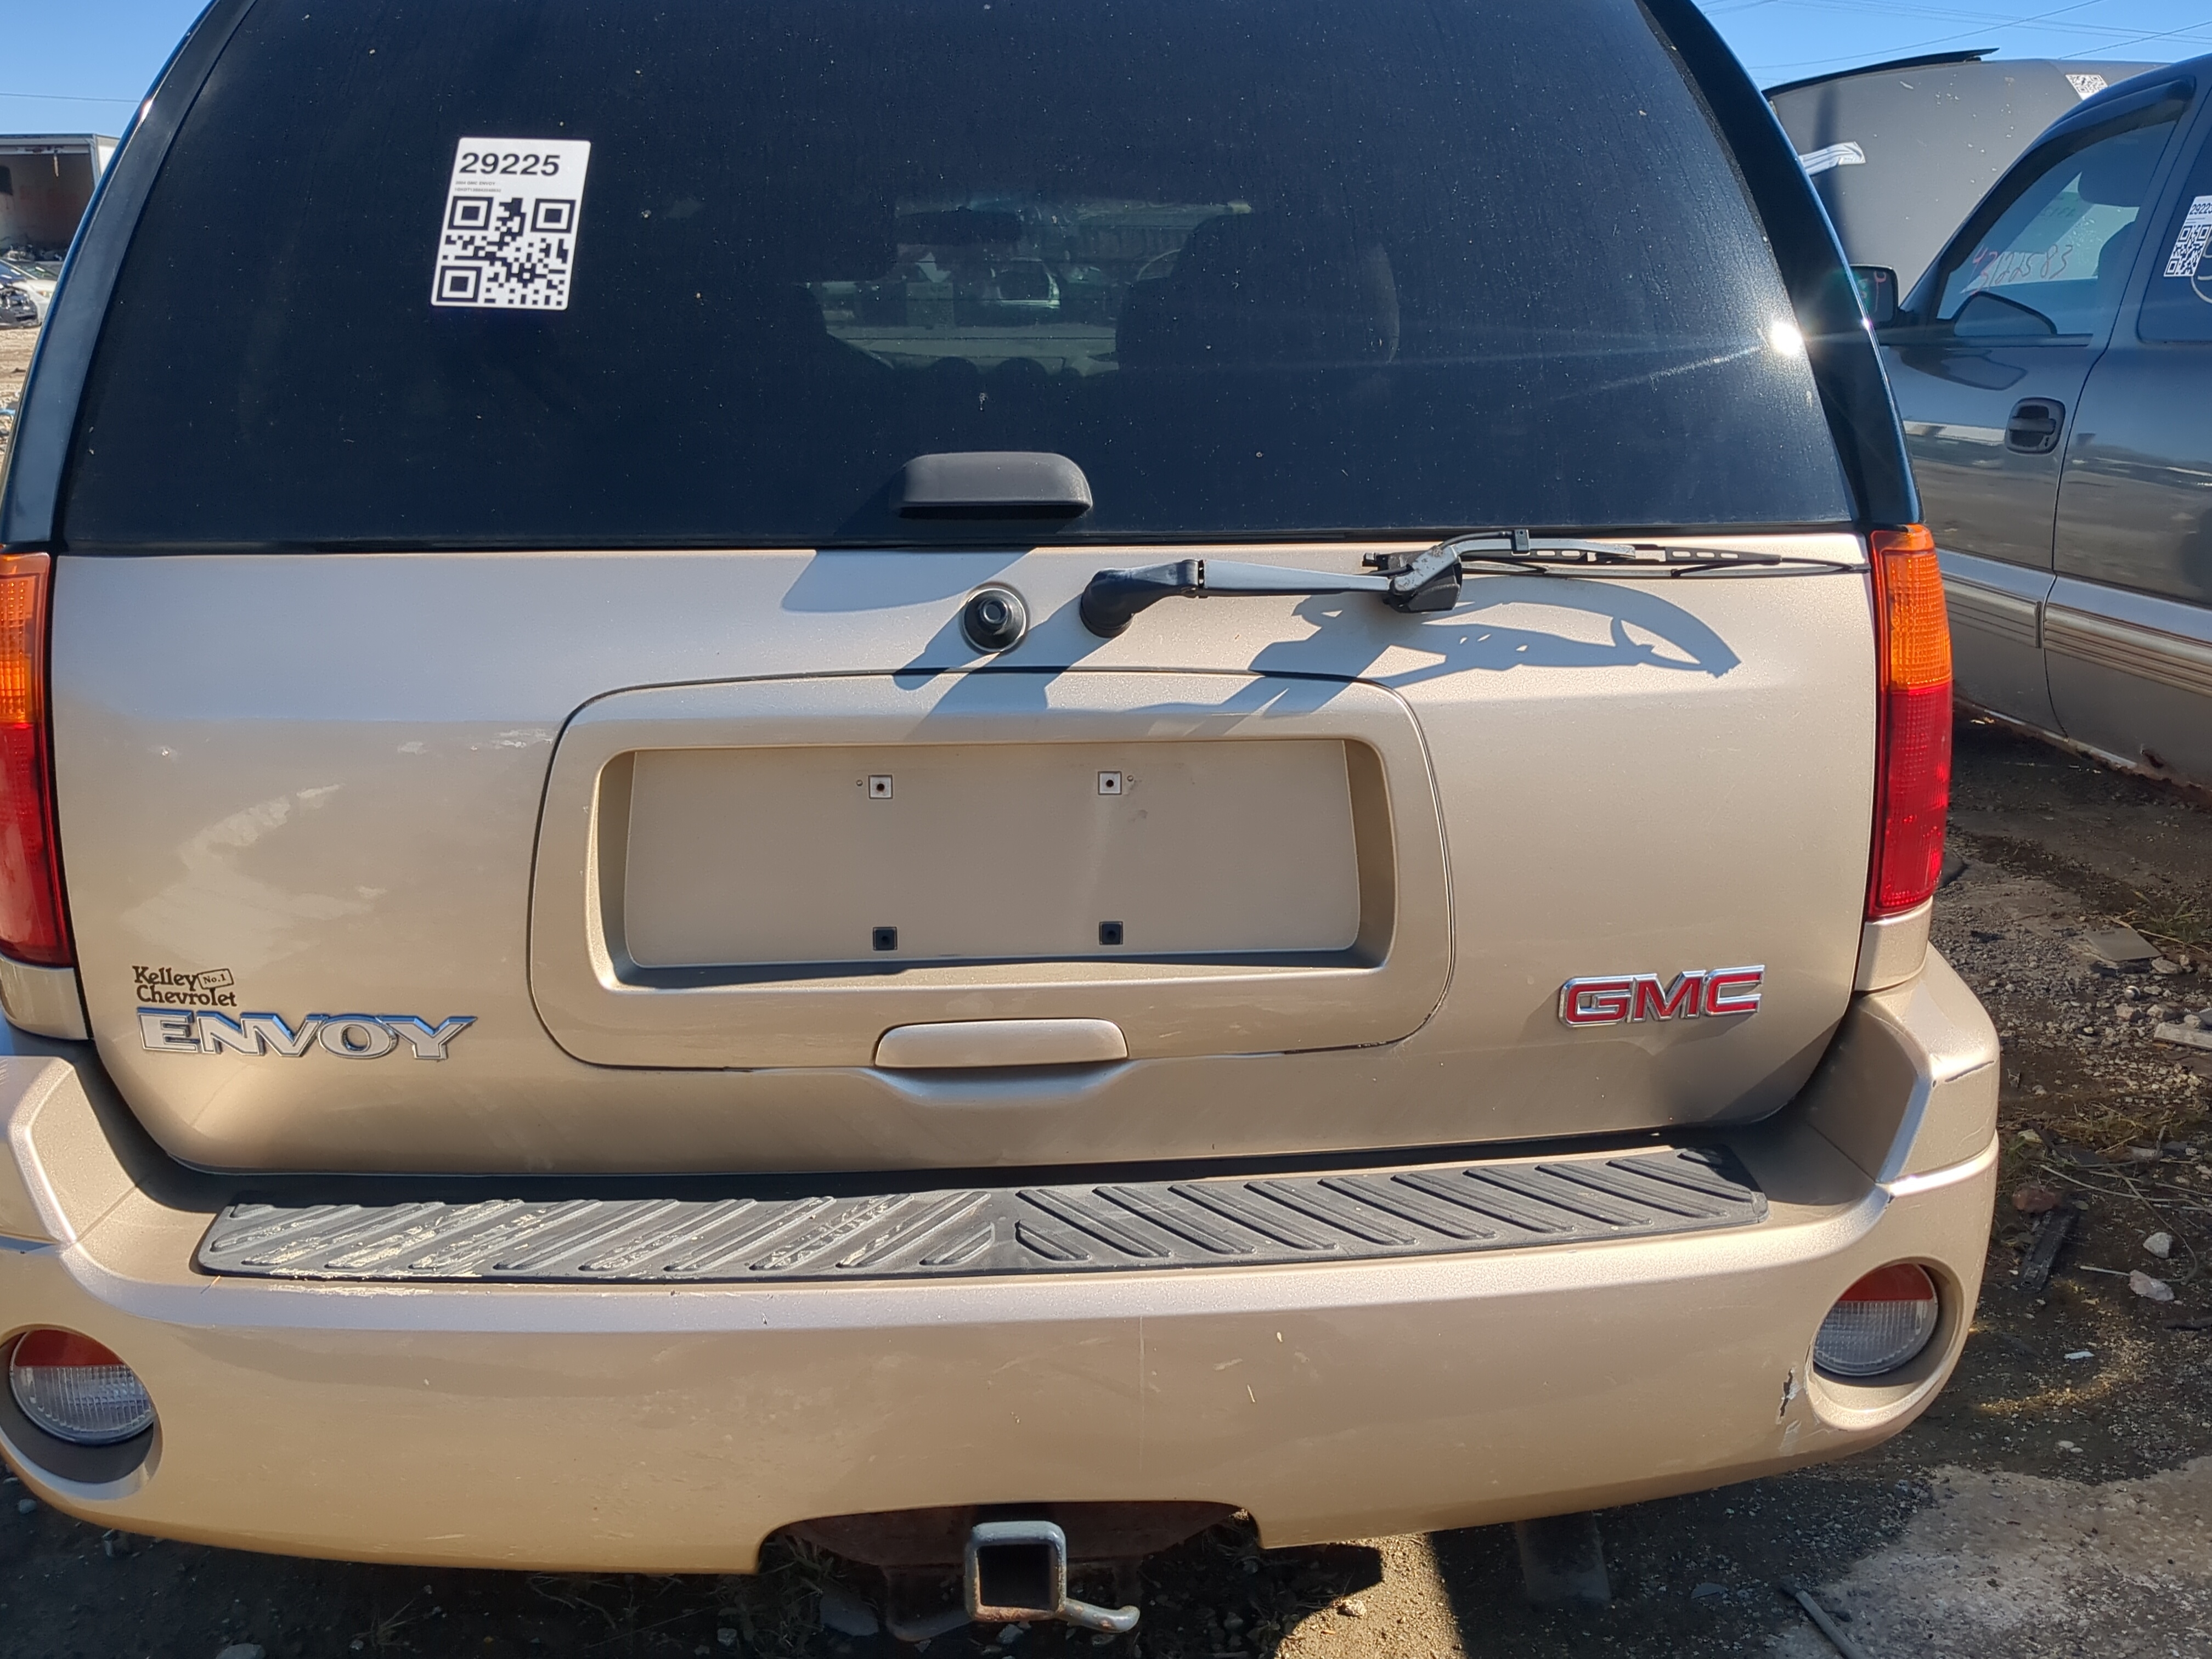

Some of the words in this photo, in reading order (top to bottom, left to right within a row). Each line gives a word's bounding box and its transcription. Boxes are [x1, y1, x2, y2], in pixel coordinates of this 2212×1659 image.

[459, 153, 561, 177] 29225
[132, 966, 199, 991] Kelley
[203, 973, 227, 984] No.1
[137, 985, 237, 1007] Chevrolet
[1558, 964, 1765, 1029] GMC
[137, 1007, 477, 1061] ENVOY
